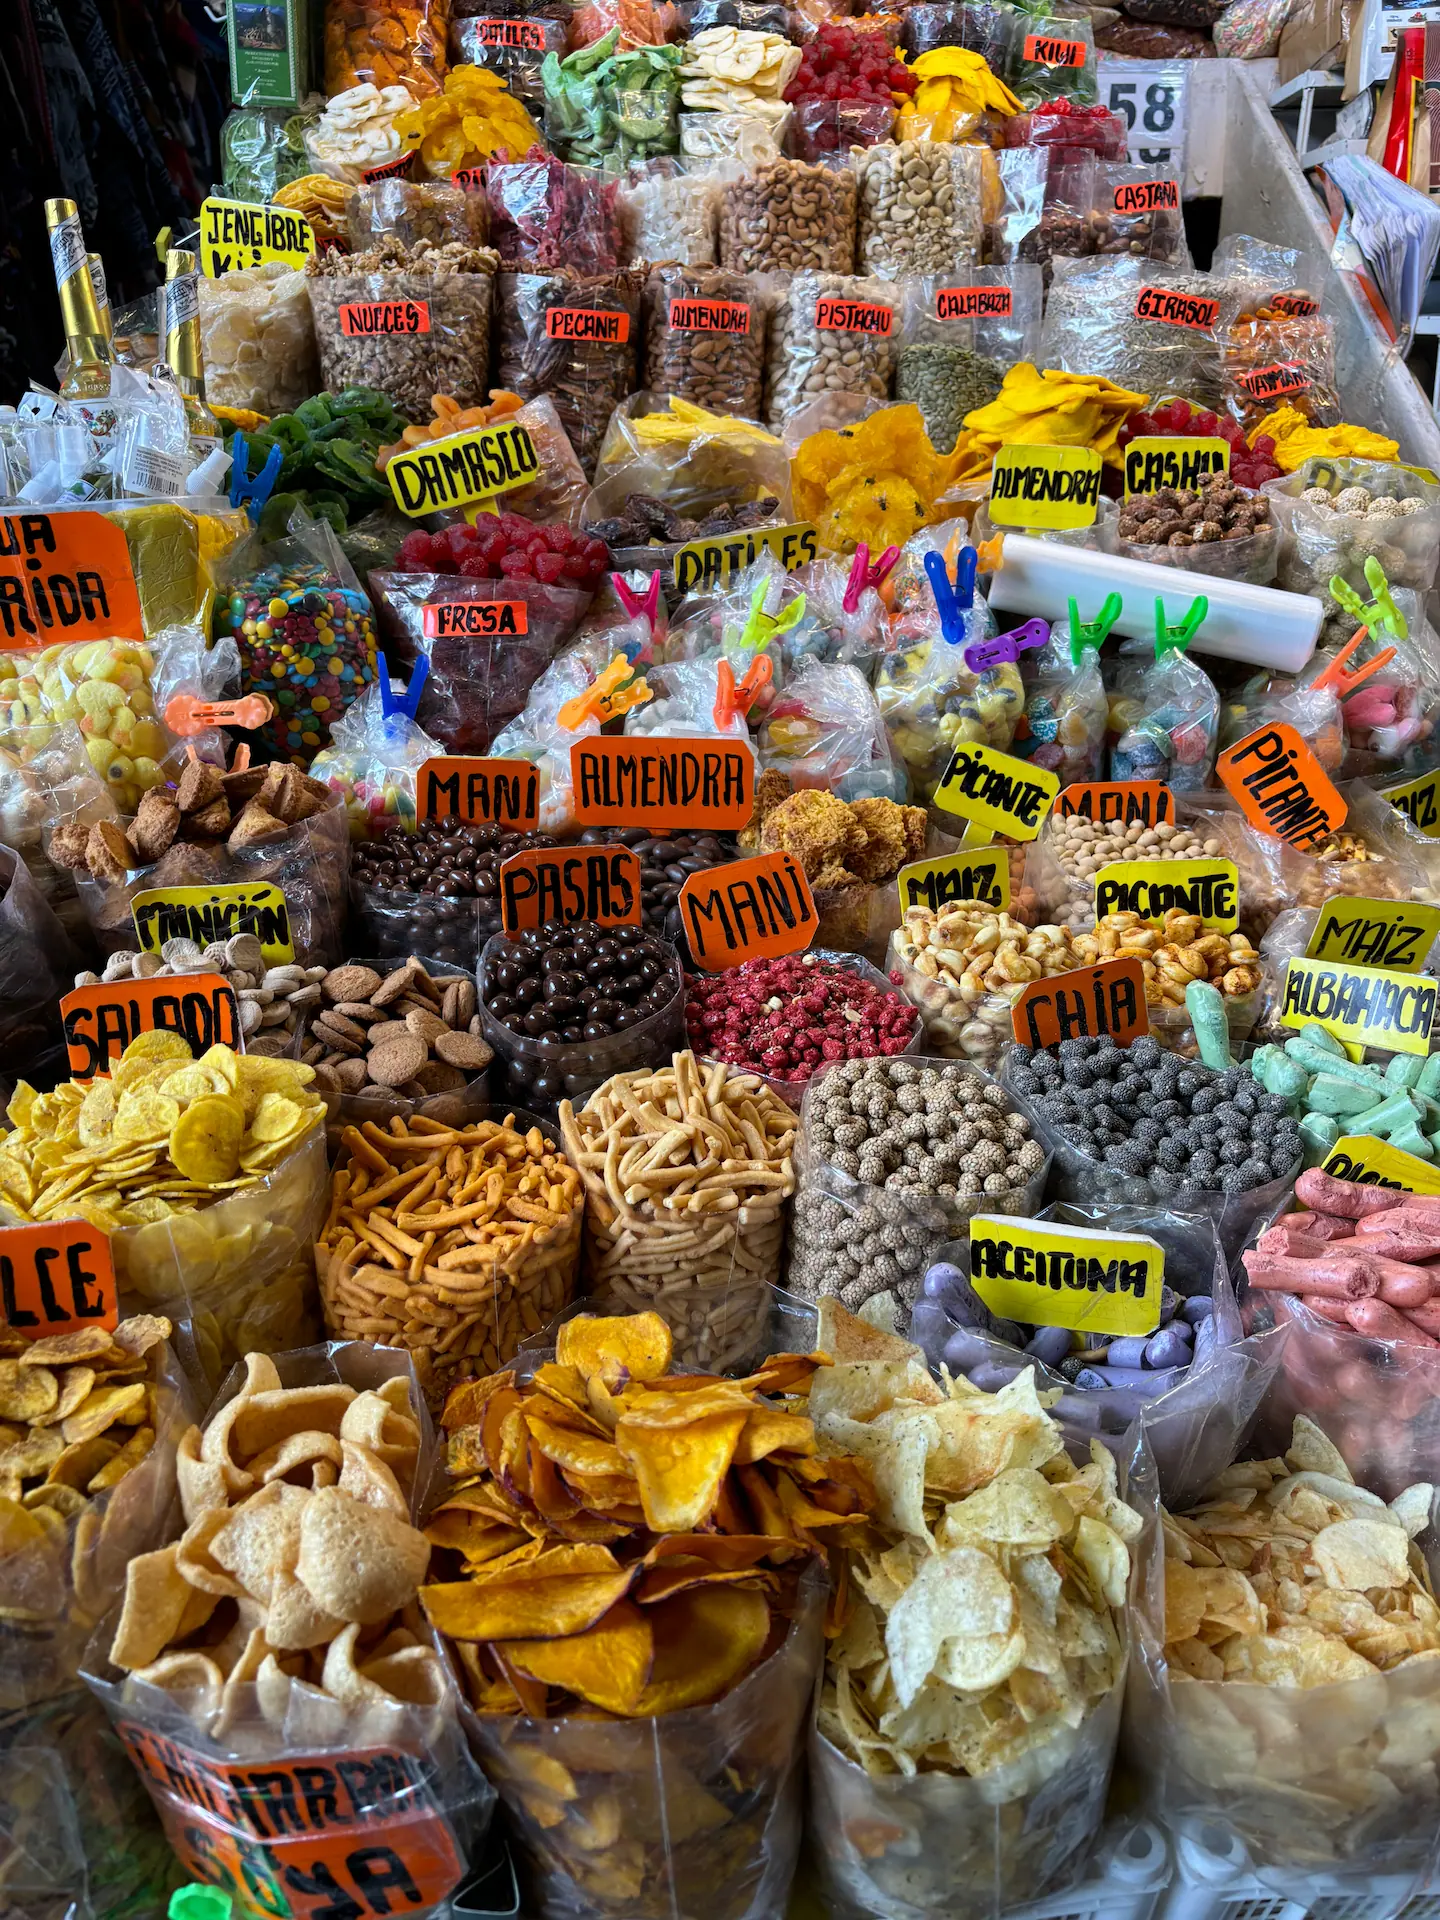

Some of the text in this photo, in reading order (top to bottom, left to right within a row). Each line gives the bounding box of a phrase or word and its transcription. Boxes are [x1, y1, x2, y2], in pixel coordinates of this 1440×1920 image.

[1034, 40, 1077, 65] KIWI
[1109, 83, 1175, 132] 58
[1114, 181, 1178, 211] CASTAÑA
[347, 303, 419, 333] NUECES
[551, 311, 619, 340] PECANA
[672, 306, 747, 331] ALMENDRA
[937, 293, 1010, 318] CALABAZA
[1137, 290, 1214, 326] GIRASOL
[393, 426, 538, 510] DAMASCO
[991, 466, 1101, 506] ALMENDRA
[438, 605, 517, 634] FRESA
[580, 752, 744, 812] ALMENDRA
[941, 750, 1050, 827] PICANTE
[503, 853, 634, 931] PASAS
[1096, 873, 1236, 922] PICANTE
[1282, 969, 1436, 1039] ALBAHACA
[971, 1238, 1148, 1298] ACEITUNA
